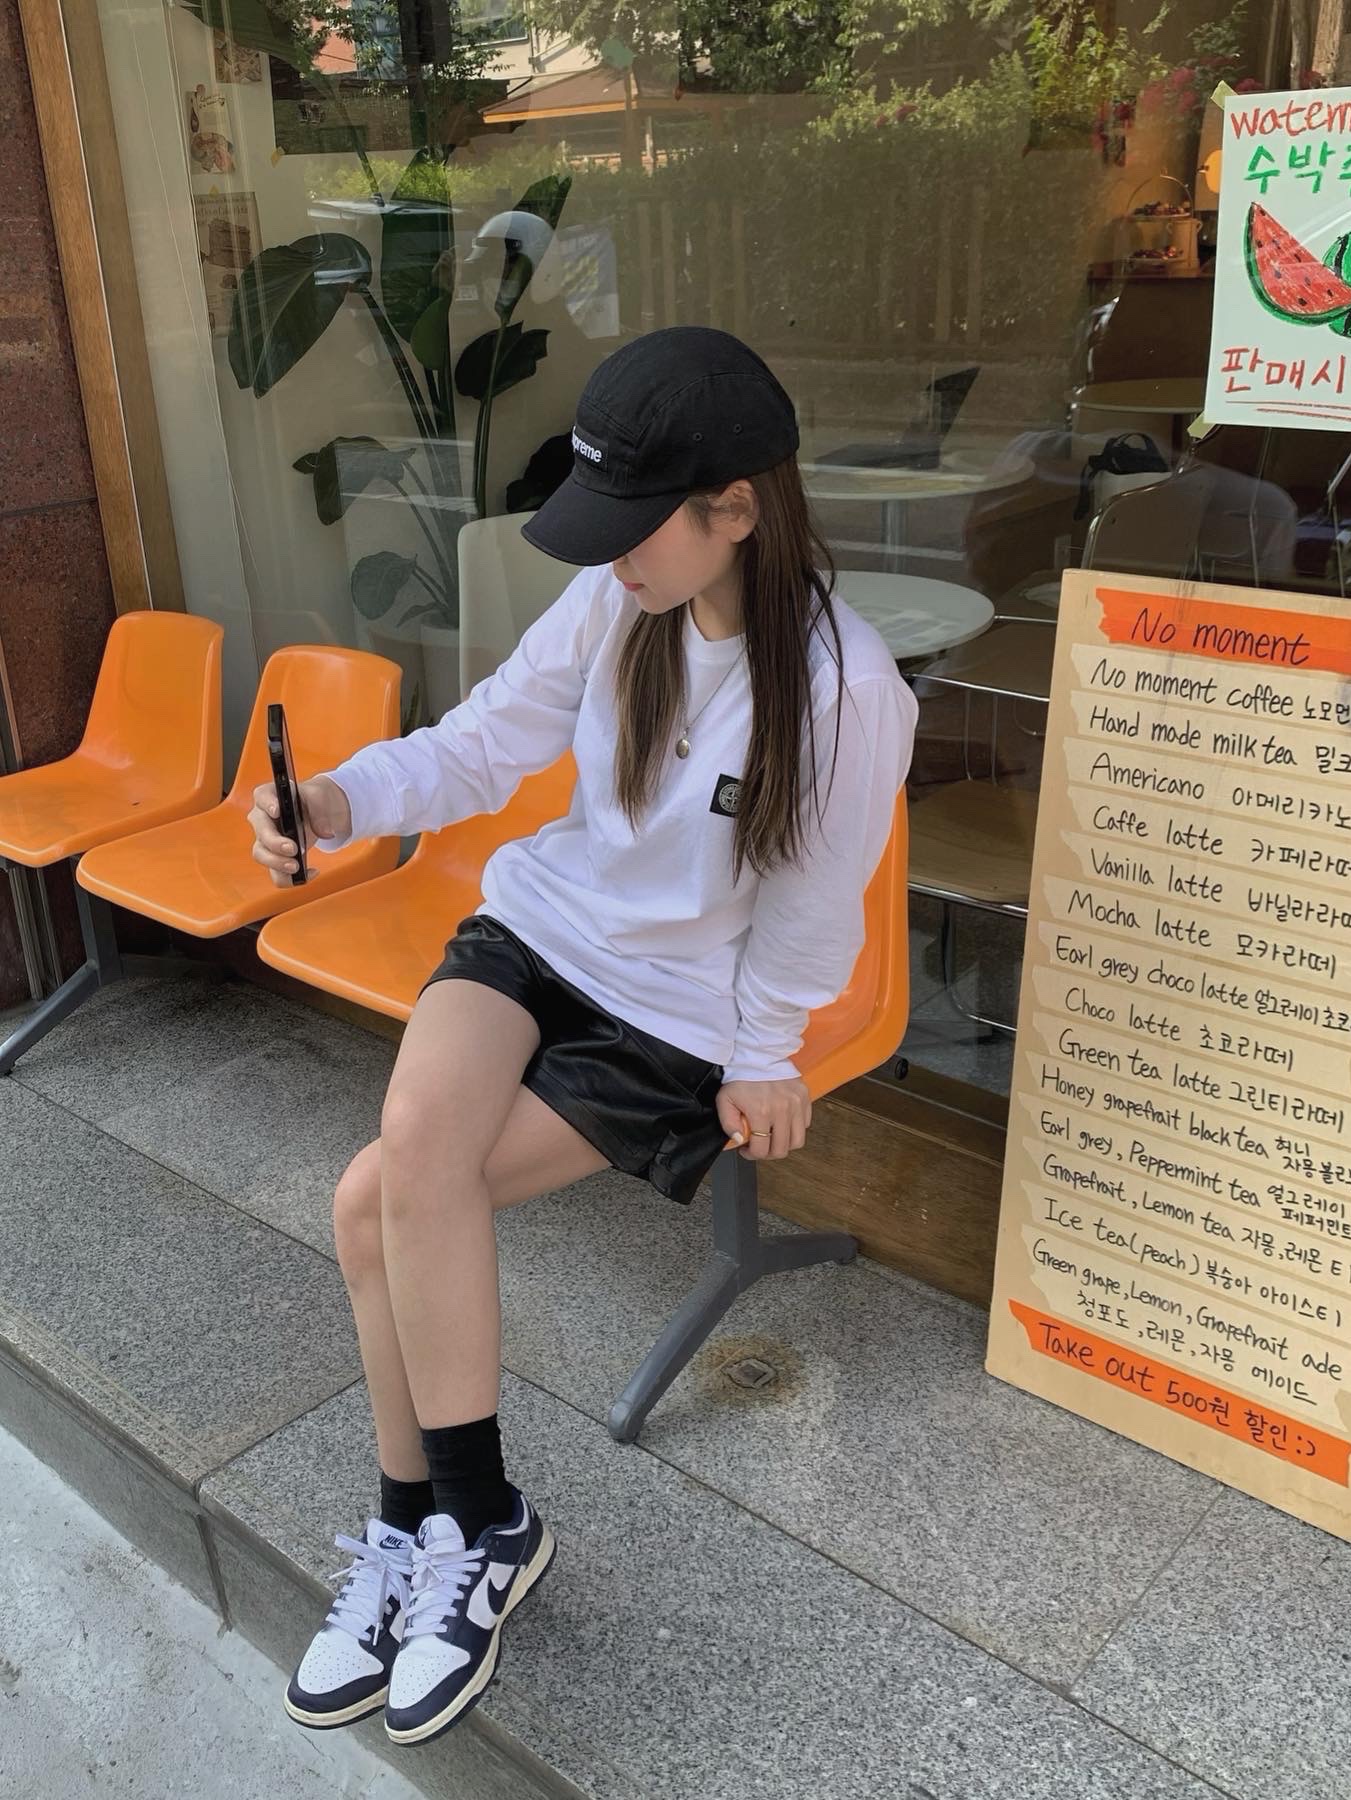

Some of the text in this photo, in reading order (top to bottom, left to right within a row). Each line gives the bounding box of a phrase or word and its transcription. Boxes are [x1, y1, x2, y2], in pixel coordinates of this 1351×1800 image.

[1221, 347, 1346, 393] 판매시
[1131, 607, 1311, 666] No moment
[1091, 658, 1126, 688] No
[1135, 670, 1217, 704] moment
[1226, 684, 1294, 716] coffee
[1090, 705, 1140, 738] Hand
[1151, 720, 1201, 749] made
[1262, 735, 1298, 766] tea
[1090, 752, 1351, 830] Americano 아메리카노
[1093, 805, 1149, 837] Caffe
[1166, 819, 1224, 855] latte
[1091, 848, 1154, 885] Vanilla
[1167, 864, 1224, 902] latte
[1068, 889, 1336, 980] Mocha latte 모카라떼
[1056, 935, 1092, 968] Earl
[1098, 957, 1139, 984] grey
[1147, 959, 1195, 993] choco
[1201, 972, 1249, 1009] latte
[1058, 1028, 1120, 1072] Green
[1128, 1048, 1163, 1081] tea
[1173, 1063, 1221, 1099] latte
[1065, 987, 1293, 1072] Choco latte 초코라떼
[1041, 1064, 1095, 1108] Honey
[1233, 1126, 1269, 1160] tea
[1275, 1135, 1310, 1157] 허니
[1041, 1111, 1070, 1141] Earl
[1129, 1140, 1223, 1195] Peppermint
[1228, 1178, 1261, 1207] tea
[1142, 1191, 1195, 1225] Lemon
[1200, 1211, 1236, 1242] tea
[1044, 1197, 1084, 1231] Ice
[1205, 1259, 1252, 1295] 복숭아
[1260, 1285, 1341, 1328] 아이스티
[1032, 1238, 1077, 1277] Green
[1301, 1352, 1342, 1381] ade
[1039, 1321, 1095, 1367] Take
[1105, 1357, 1155, 1392] out
[1165, 1380, 1230, 1427] 500원
[1243, 1409, 1287, 1450] 할인
[1251, 1365, 1318, 1406] 에이드
